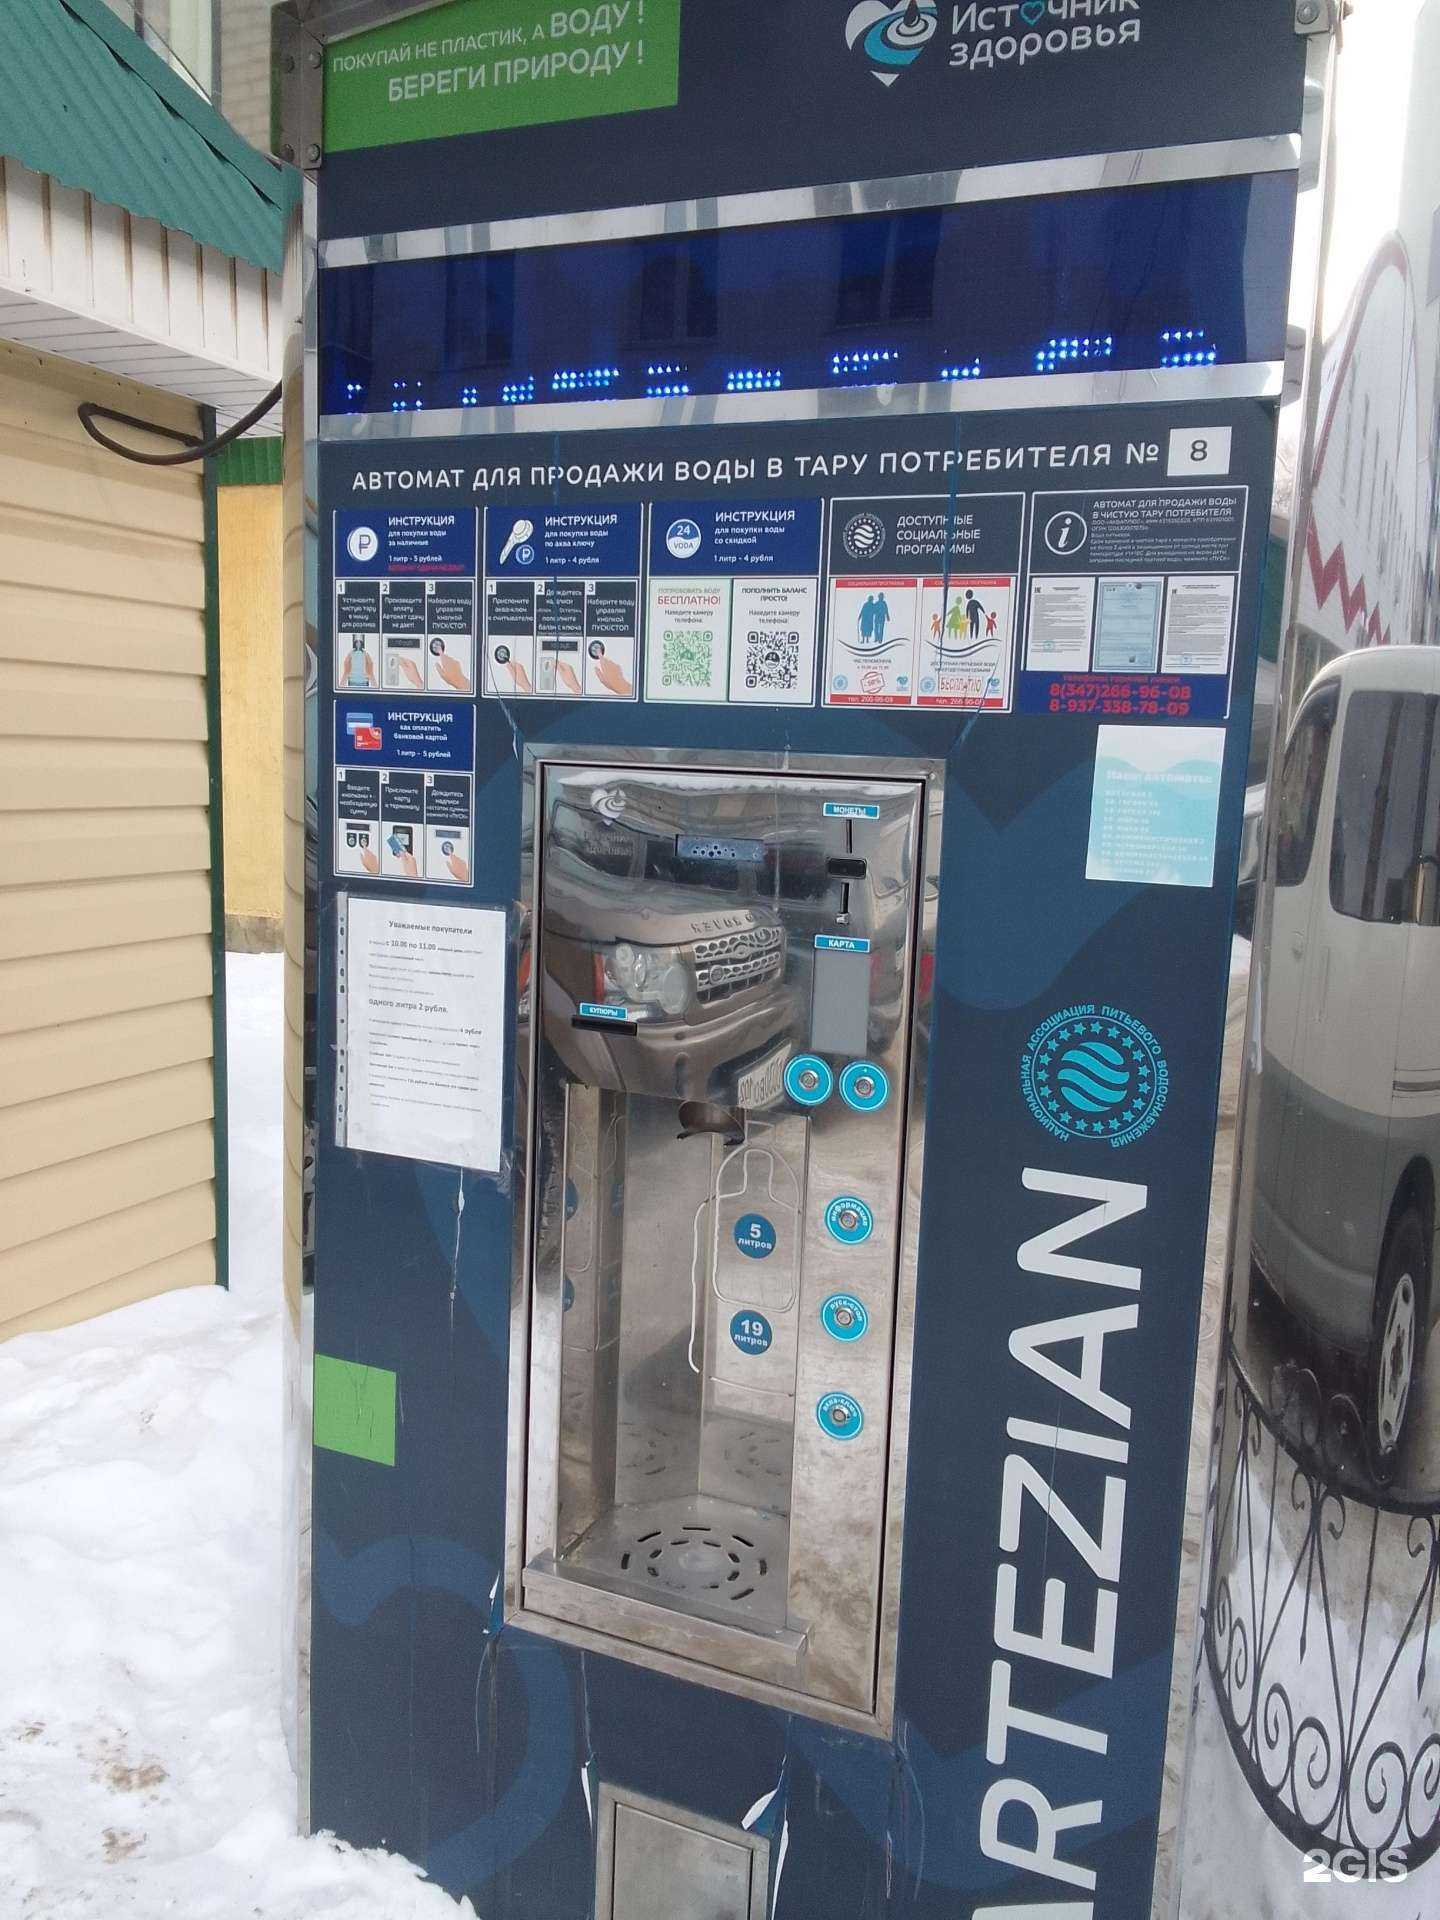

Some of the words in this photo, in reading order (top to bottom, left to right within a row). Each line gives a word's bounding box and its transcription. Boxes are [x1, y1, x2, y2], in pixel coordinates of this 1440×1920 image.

[333, 43, 411, 72] ПОКУПАЙ
[415, 41, 437, 60] НЕ
[441, 26, 527, 56] ПЛАСТИК,
[532, 24, 546, 41] А
[550, 1, 630, 37] ВОДУ
[389, 64, 486, 102] БЕРЕГИ
[494, 41, 630, 86] ПРИРОДУ
[352, 469, 464, 491] АВТОМАТ
[473, 467, 521, 491] ДЛЯ
[530, 462, 664, 488] ПРОДАЖИ
[675, 458, 755, 485] ВОДЫ
[767, 458, 782, 478] В
[794, 453, 868, 478] ТАРУ
[879, 444, 1110, 476] ПОТРЕБИТЕЛЯ
[1125, 443, 1159, 464] №
[1189, 439, 1208, 462] 8
[1093, 500, 1137, 509] АВТОМАТ
[1138, 500, 1157, 509] ДЛЯ
[1158, 498, 1208, 508] ПРОДАЖИ
[1208, 497, 1237, 506] ВОДЫ
[715, 510, 796, 523] ИНСТРУКЦИЯ
[1092, 511, 1099, 519] В
[1100, 510, 1139, 519] ЧИСТУЮ
[1140, 510, 1164, 519] ТАРУ
[1165, 508, 1232, 518] ПОТРЕБИТЕЛЯ
[388, 515, 455, 526] ИНСТРУКЦИЯ
[545, 514, 618, 527] ИНСТРУКЦИЯ
[896, 514, 974, 528] ДОСТУПНЫЕ
[559, 530, 588, 538] покупки
[676, 525, 691, 536] 24
[731, 526, 763, 535] покупки
[764, 526, 785, 534] воды
[896, 529, 981, 542] СОЦИАЛЬНЫЕ
[724, 536, 757, 545] скидкой
[896, 544, 976, 555] ПРОГРАММЫ
[750, 555, 774, 563] рубля
[587, 584, 593, 593] 3
[657, 595, 721, 606] БЕСПЛАТНО!
[387, 711, 454, 723] ИНСТРУКЦИЯ
[833, 806, 866, 815] МОНЕТЫ
[388, 920, 431, 932] Уважаемые
[431, 926, 473, 936] покупатели
[828, 938, 855, 949] КАРТА
[589, 1007, 618, 1016] КУПЮРЫ
[1027, 1004, 1095, 1051] АССОЦИАЦИЯ
[1101, 1005, 1162, 1055] ПИТЬЕВОГО
[1020, 1055, 1070, 1142] НАЦИОНАЛЬНАЯ
[1110, 1060, 1169, 1148] ВОДОСНАБЖЕНИЯ
[750, 1223, 761, 1239] 5
[738, 1237, 772, 1251] литров
[741, 1319, 764, 1337] 19
[734, 1333, 768, 1348] литров
[972, 1166, 1148, 1920] RTEZIAN
